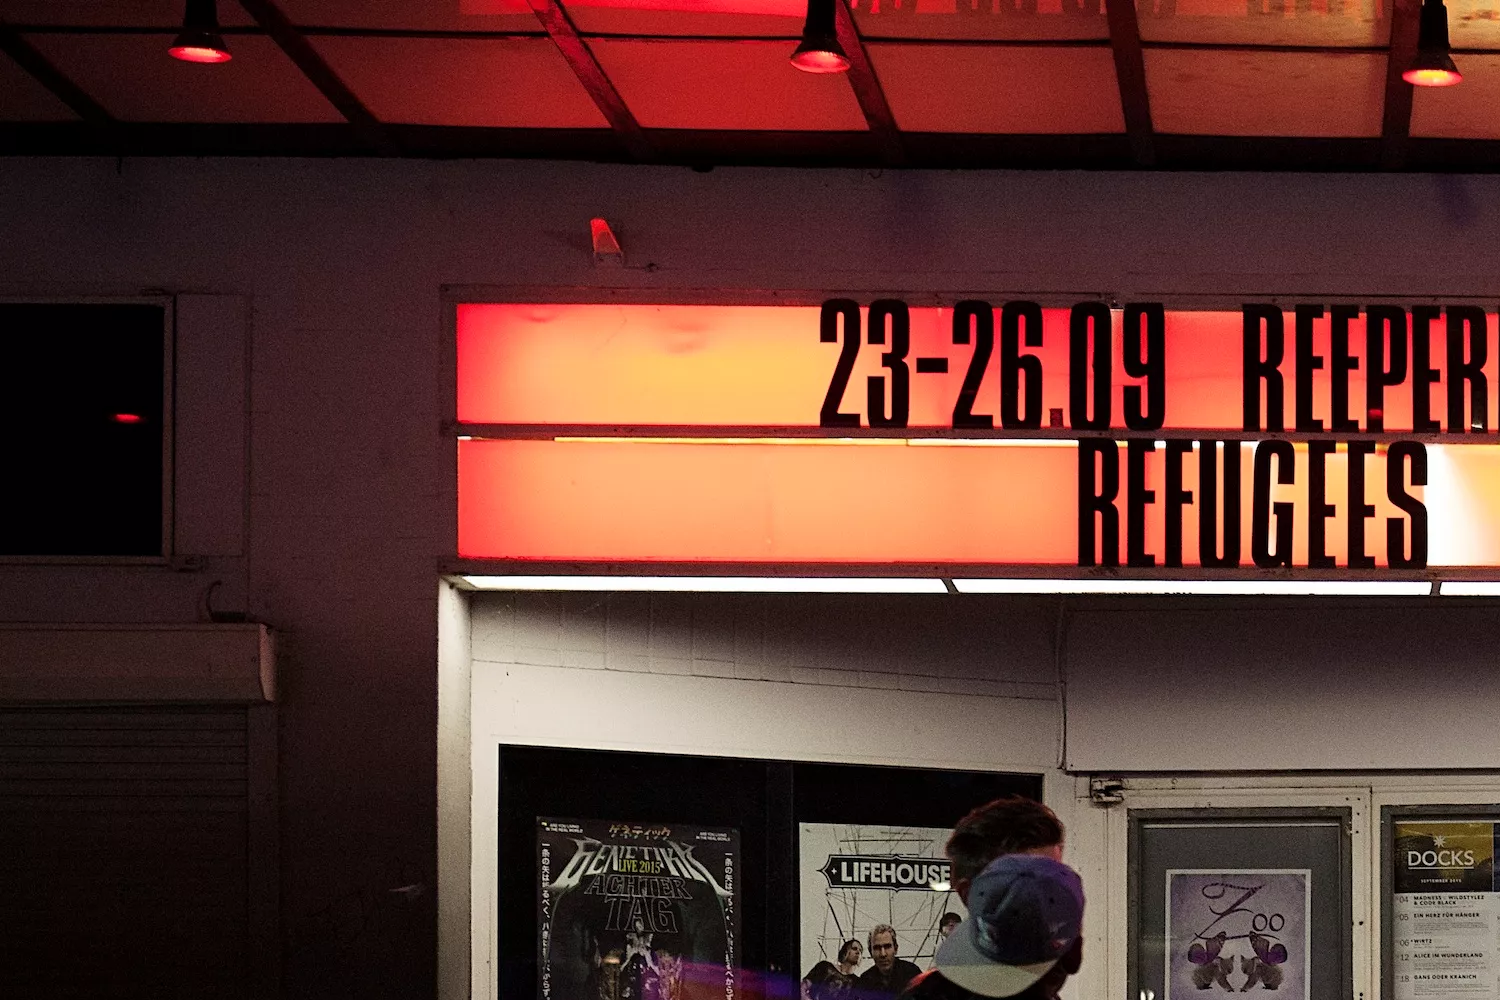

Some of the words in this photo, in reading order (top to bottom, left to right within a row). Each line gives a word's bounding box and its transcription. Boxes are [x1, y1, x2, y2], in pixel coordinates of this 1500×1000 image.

[819, 299, 1166, 431] 23-26.09
[1079, 438, 1428, 570] REFUGEES
[618, 859, 639, 873] LIVE
[639, 861, 661, 874] 2015
[1408, 850, 1475, 866] DOCKS
[840, 861, 951, 884] LIFEHOUSE
[583, 874, 693, 900] ACHTER
[604, 895, 678, 934] TAG
